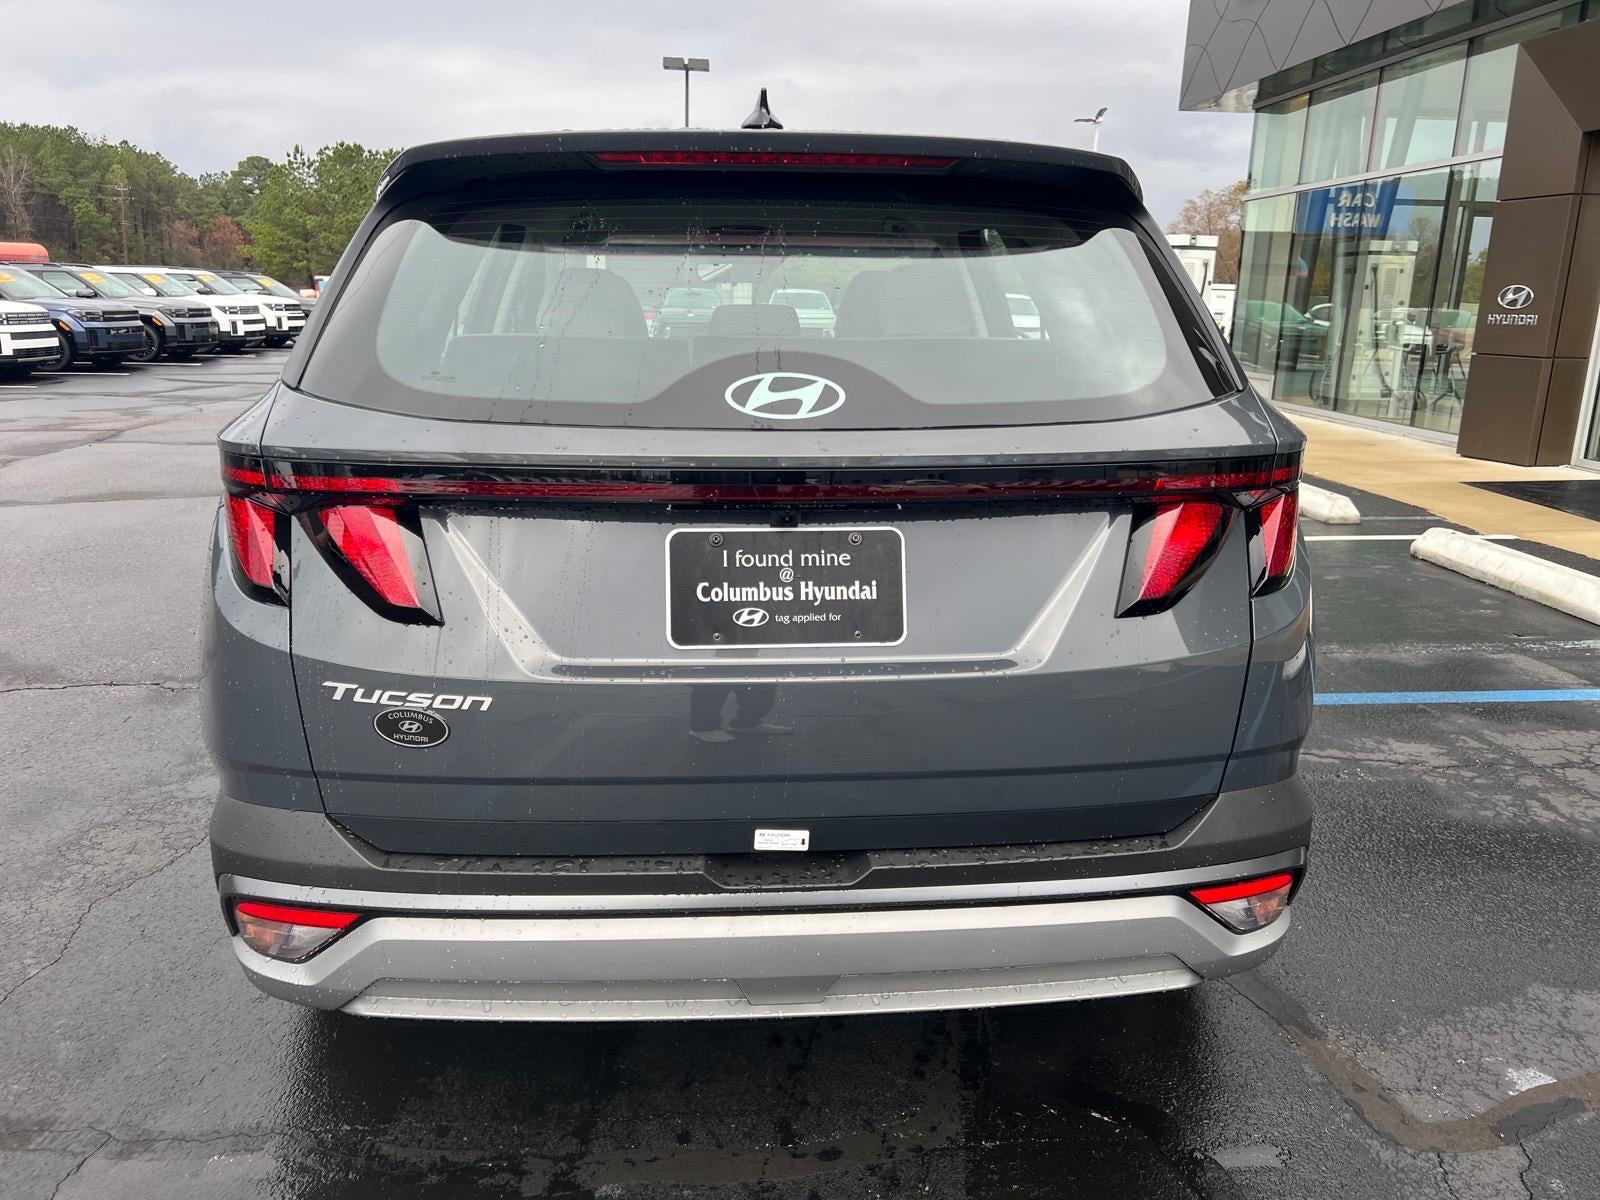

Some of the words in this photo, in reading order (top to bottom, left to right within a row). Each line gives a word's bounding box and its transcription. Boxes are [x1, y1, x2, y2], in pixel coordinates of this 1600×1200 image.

[1487, 313, 1538, 326] HYUNDAI
[722, 550, 728, 567] I
[735, 549, 793, 567] found
[800, 549, 851, 567] mine
[779, 567, 794, 582] @
[696, 581, 794, 602] Columbus
[799, 579, 877, 606] Hyundai
[775, 612, 790, 625] tag
[792, 612, 827, 624] applied
[829, 612, 842, 622] for
[387, 711, 434, 725] COLUMBUS
[393, 733, 429, 743] HYUNDAI
